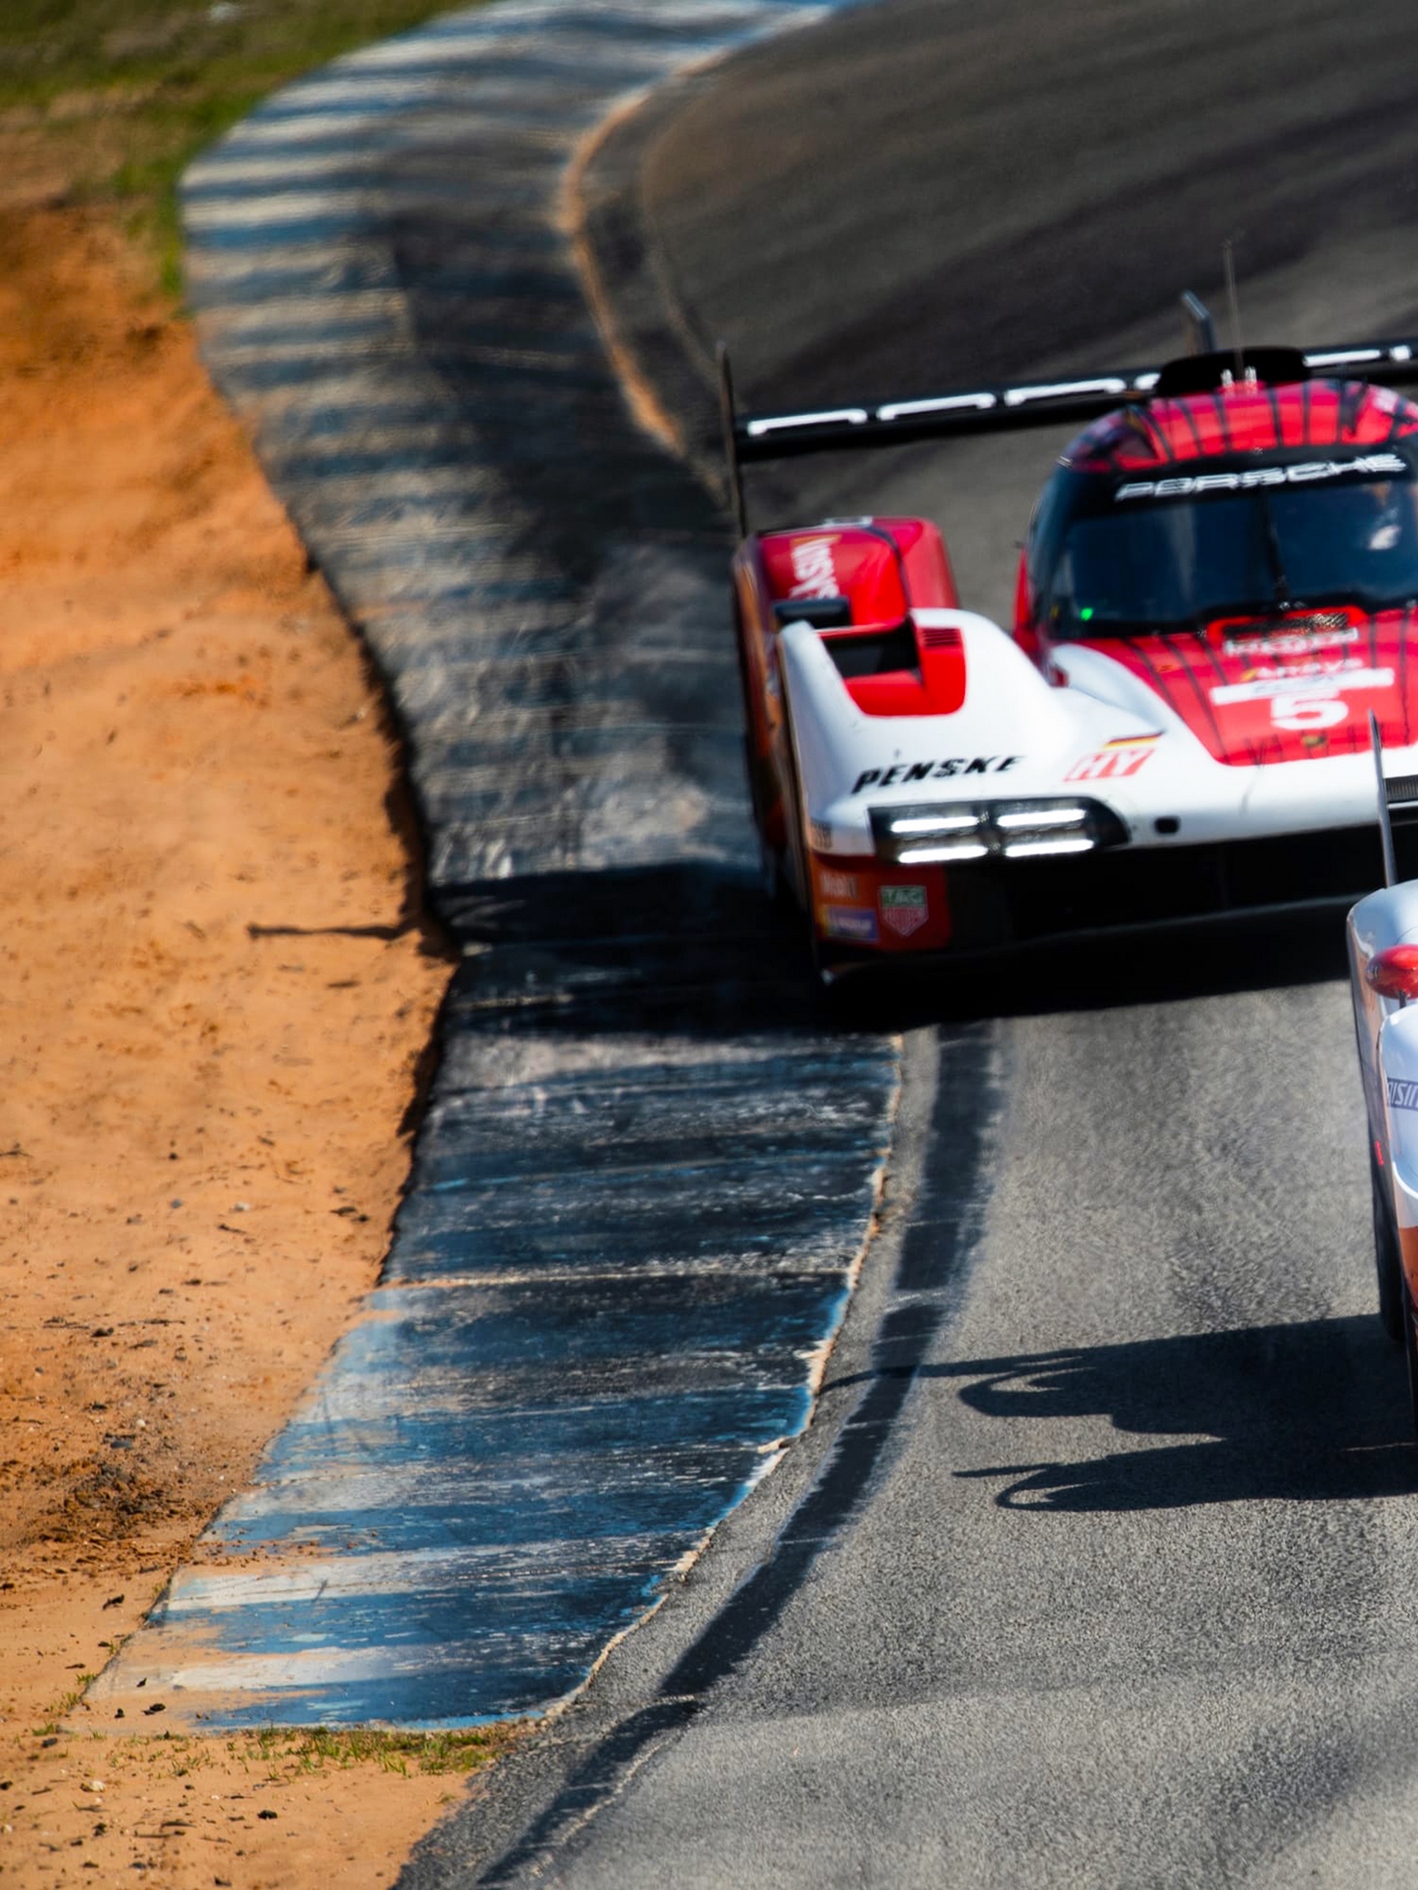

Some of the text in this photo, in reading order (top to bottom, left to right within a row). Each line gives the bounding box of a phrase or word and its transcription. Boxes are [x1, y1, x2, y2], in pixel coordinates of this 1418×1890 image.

[1114, 453, 1406, 501] PORSCHE
[1271, 687, 1348, 730] 5
[851, 755, 1024, 794] PENSKE
